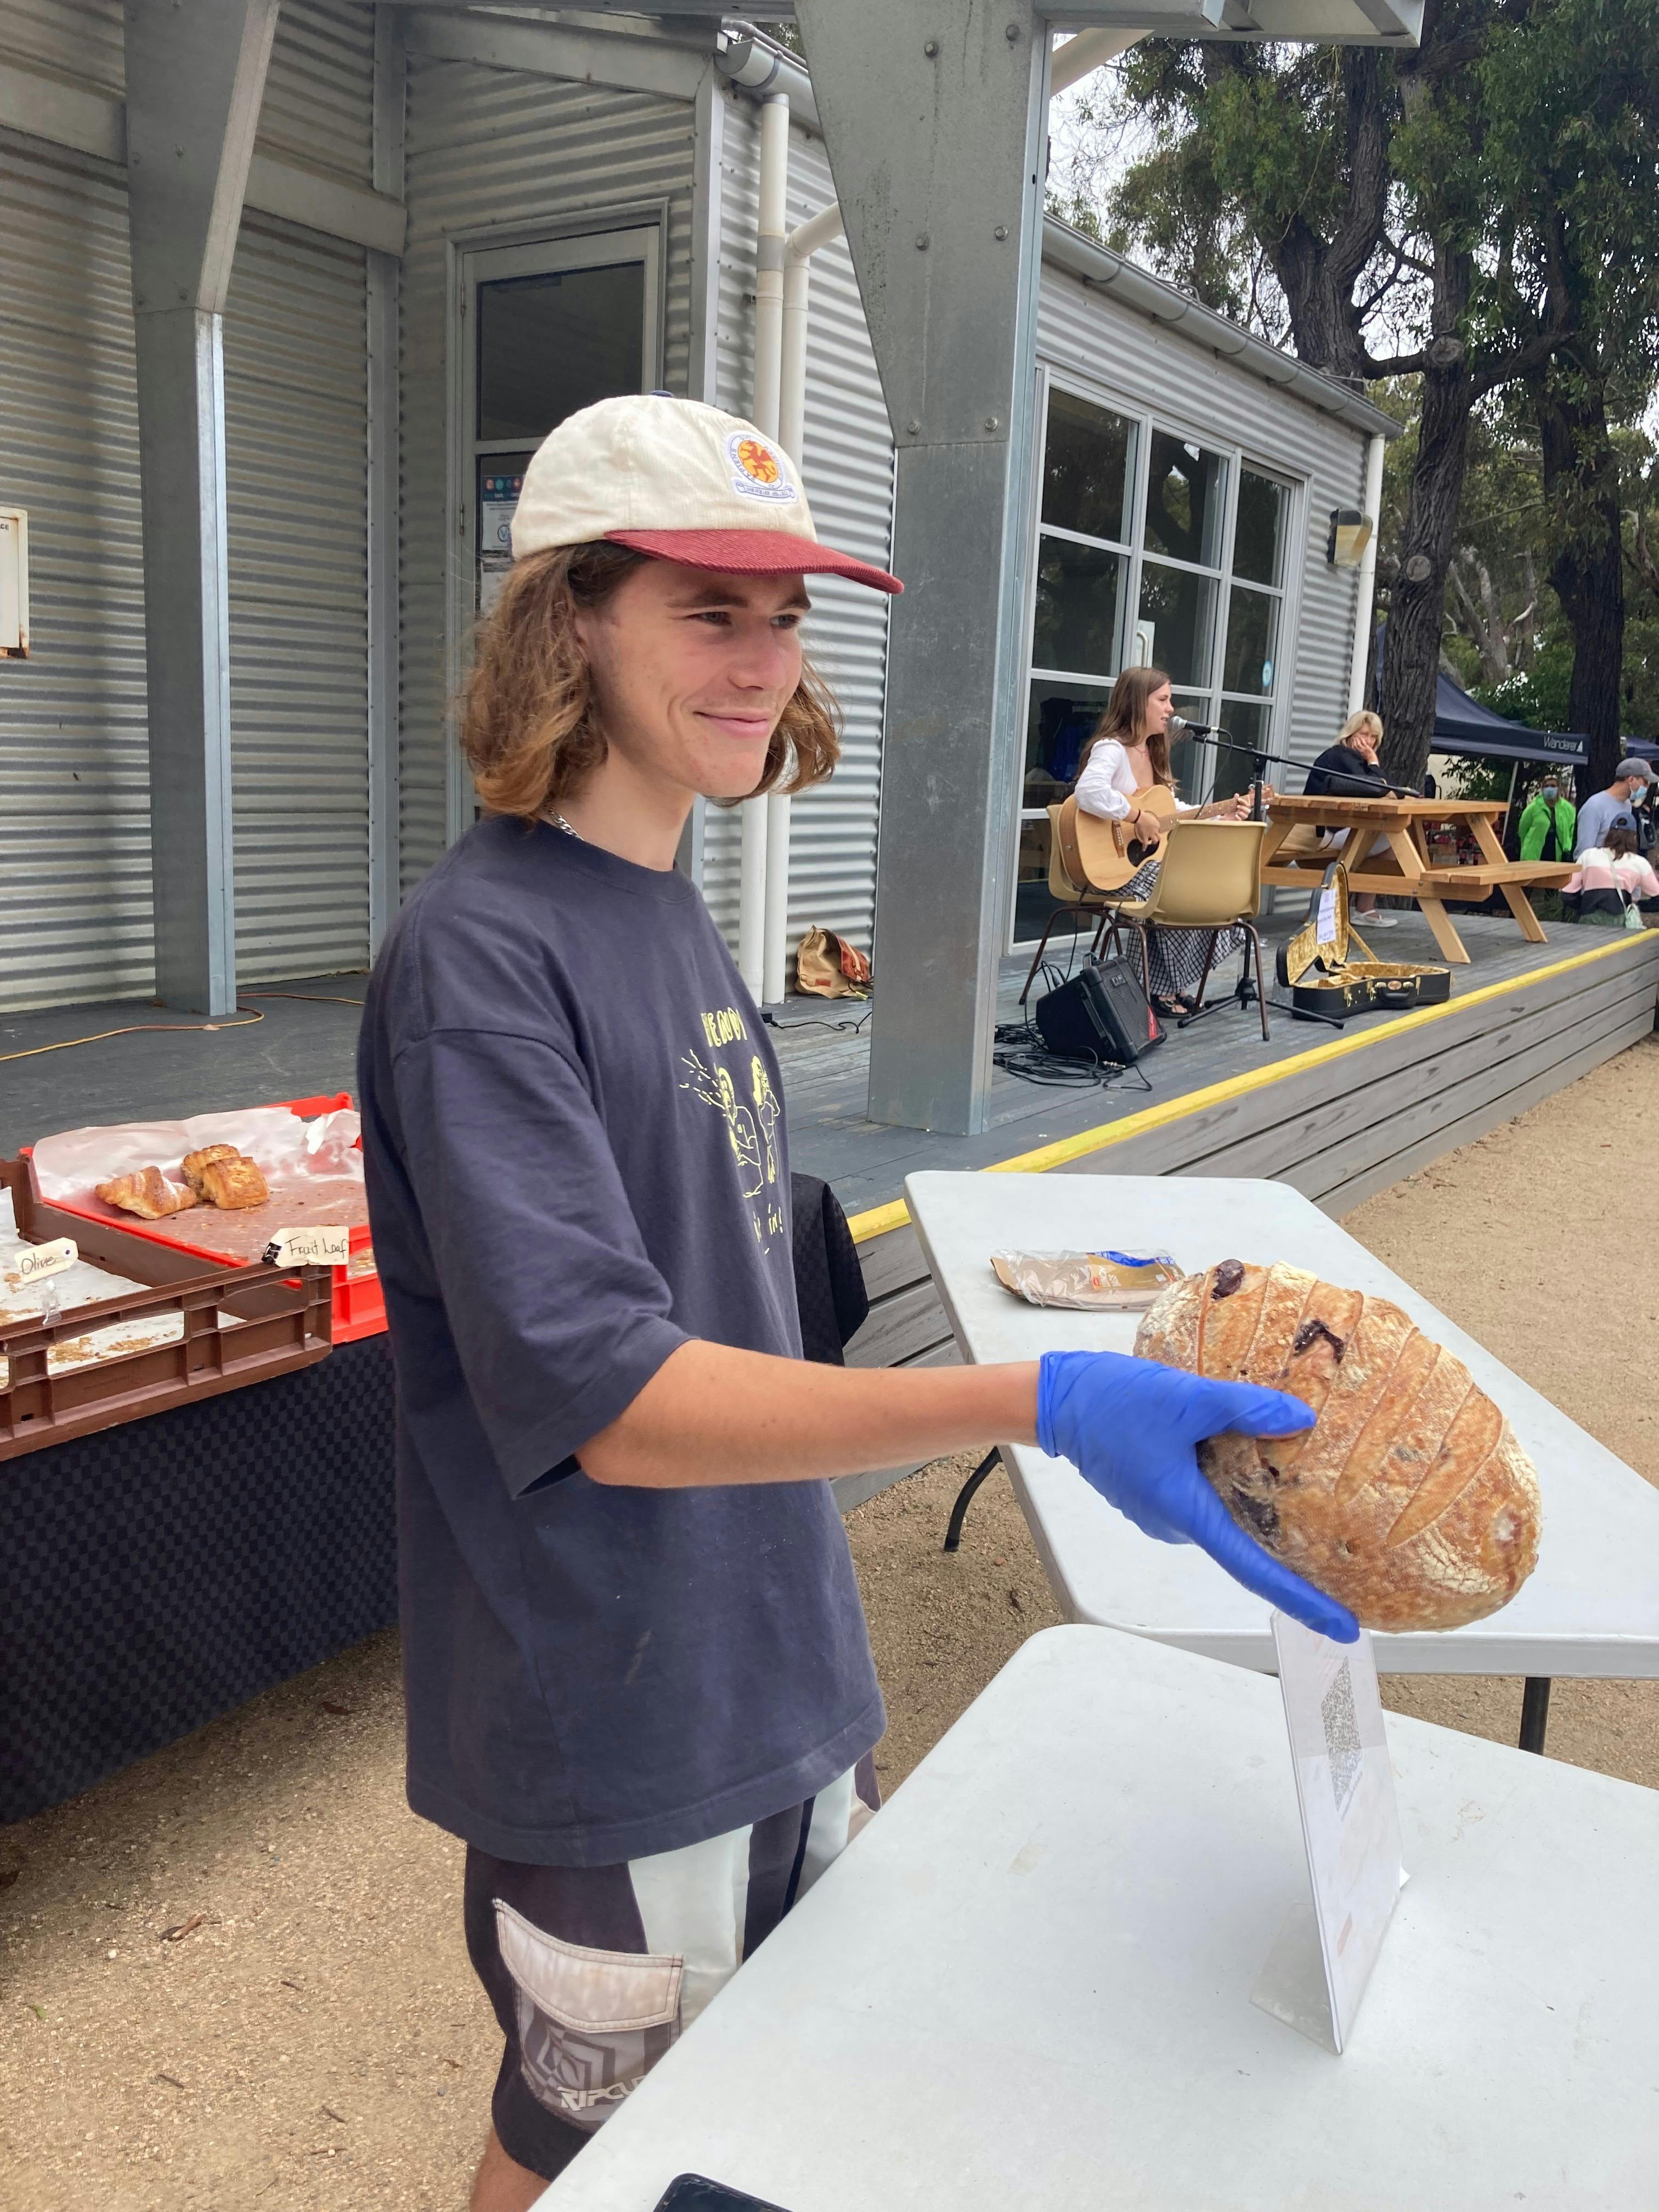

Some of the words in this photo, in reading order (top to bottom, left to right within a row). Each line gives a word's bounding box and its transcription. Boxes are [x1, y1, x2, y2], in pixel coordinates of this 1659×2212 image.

[285, 1236, 318, 1256] Fruit
[323, 1237, 348, 1259] Loaf
[21, 1252, 57, 1275] Olive
